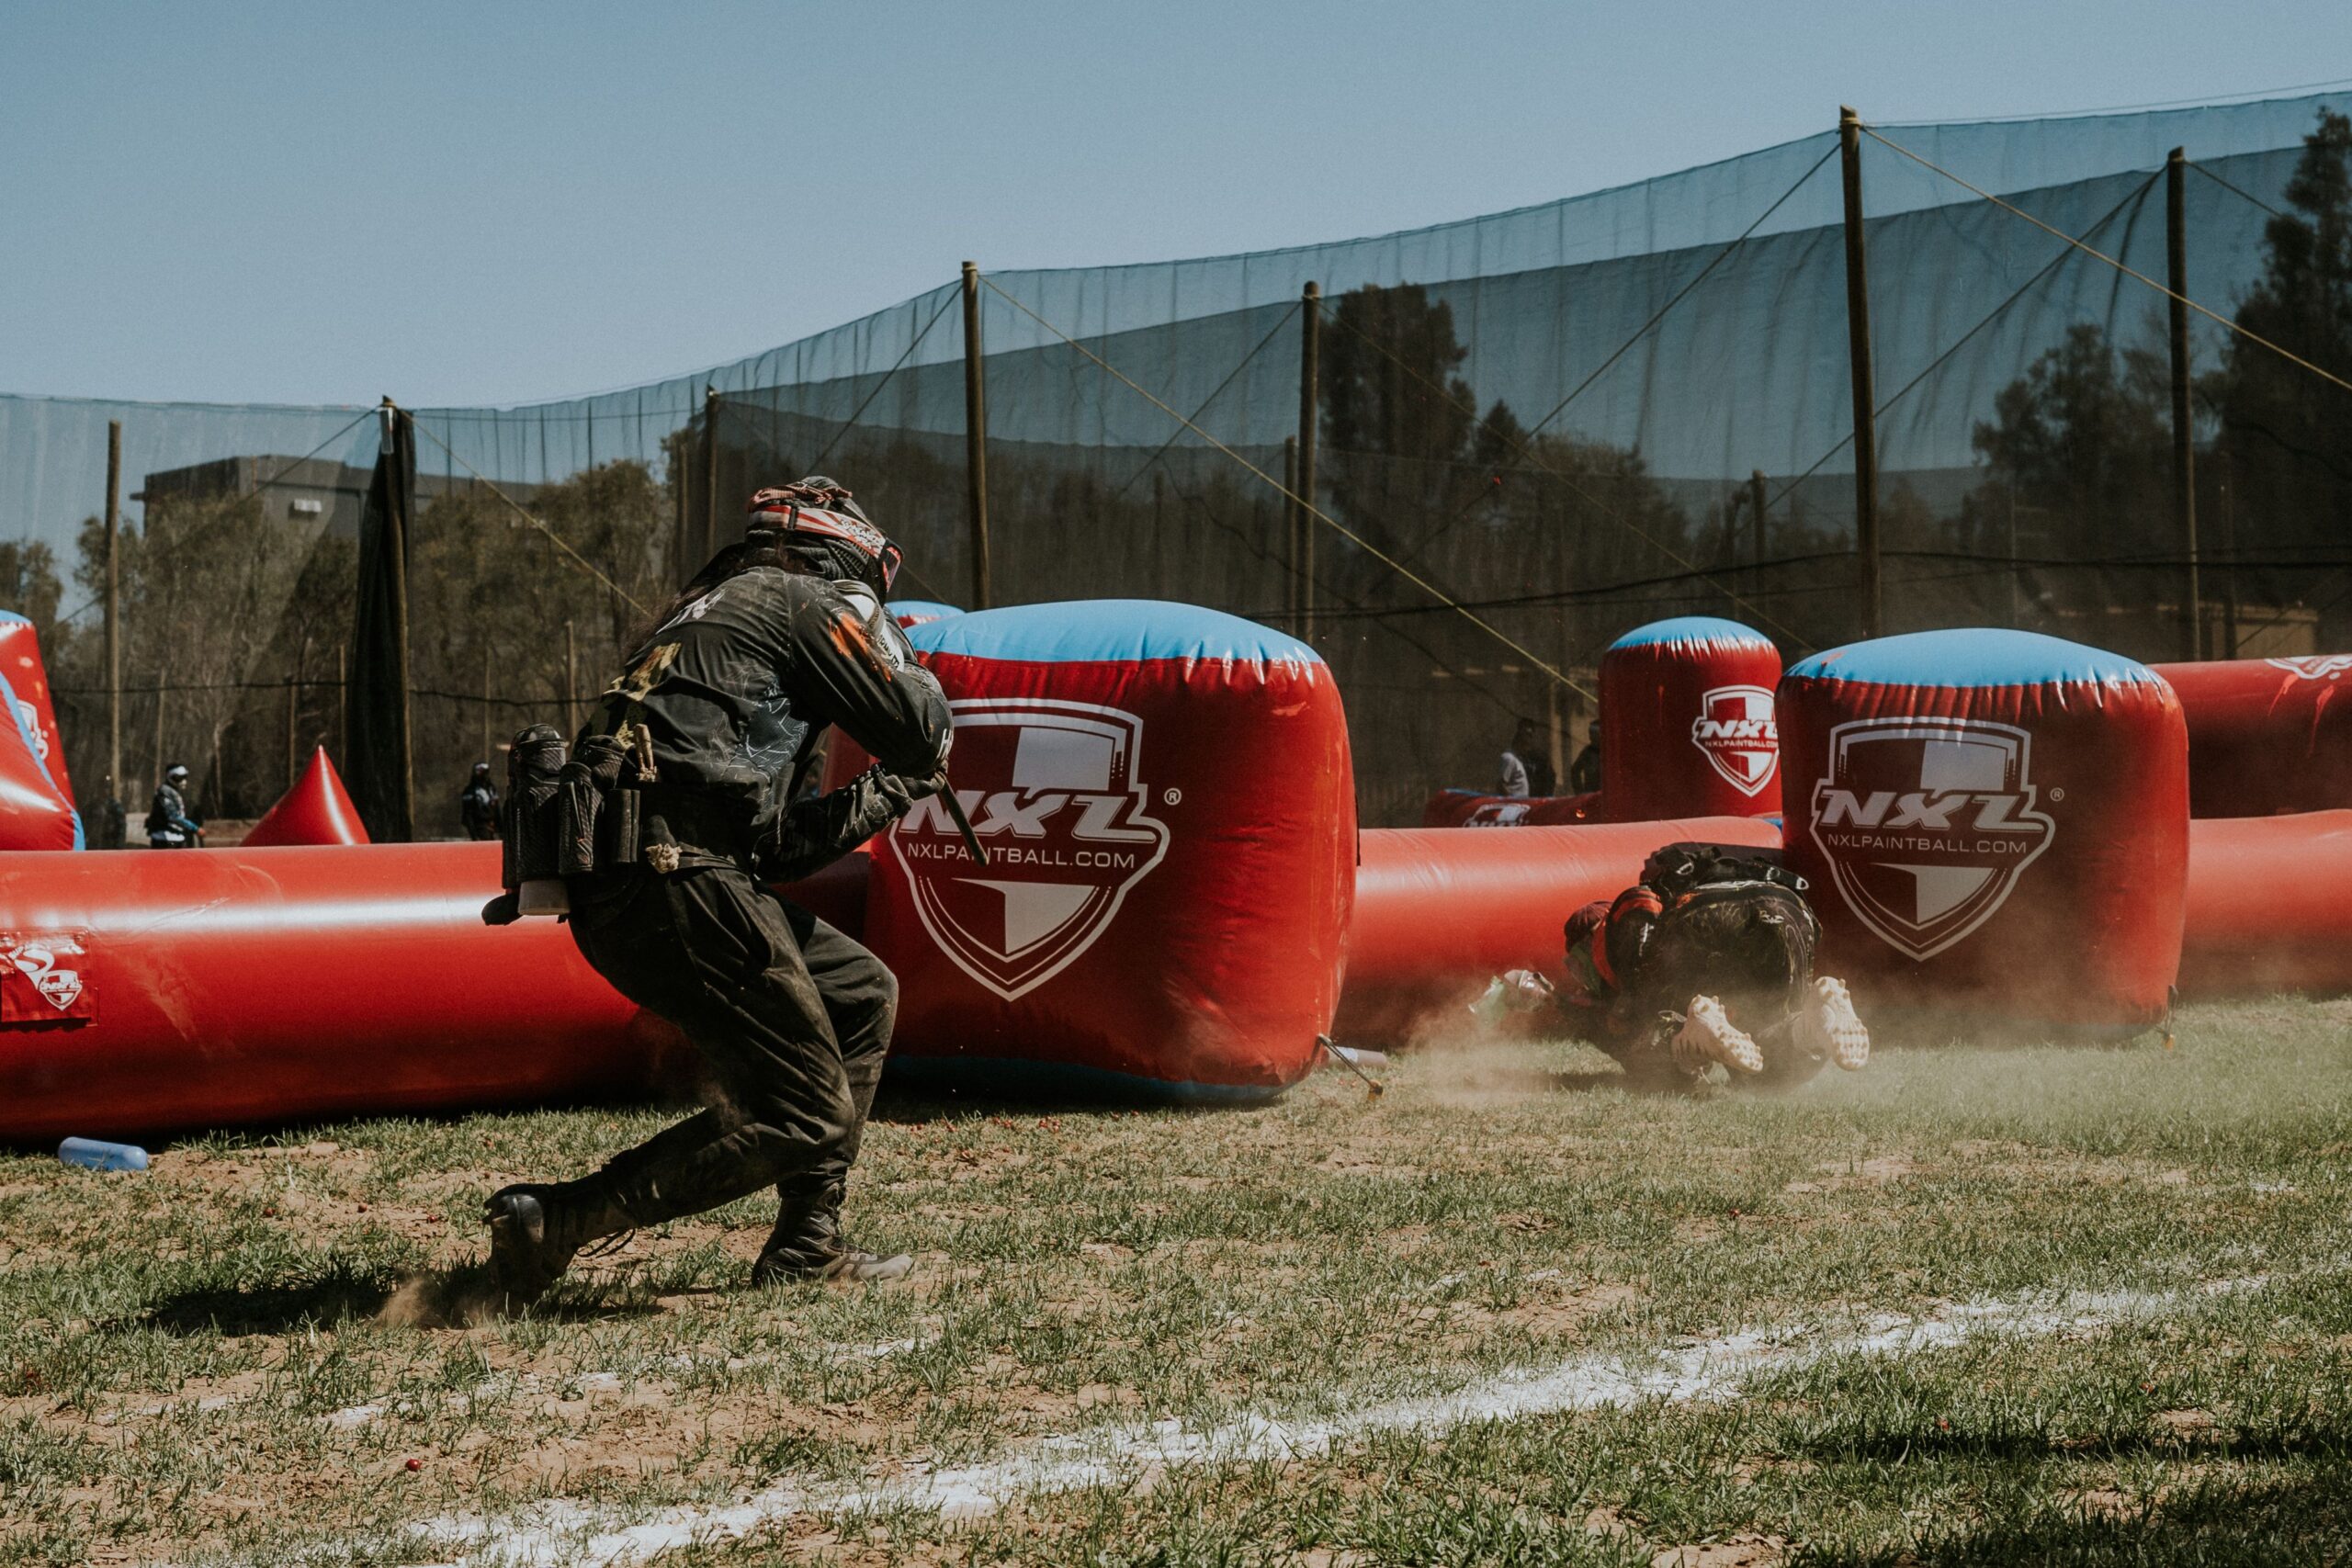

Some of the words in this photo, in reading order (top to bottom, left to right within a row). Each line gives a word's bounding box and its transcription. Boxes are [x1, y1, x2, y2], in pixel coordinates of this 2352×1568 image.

[899, 789, 1158, 843] NXL
[1819, 789, 2045, 832] NXL
[907, 842, 1136, 869] NXLPATBALL.COM
[1827, 833, 2027, 854] NXLPAINTBALL.COM
